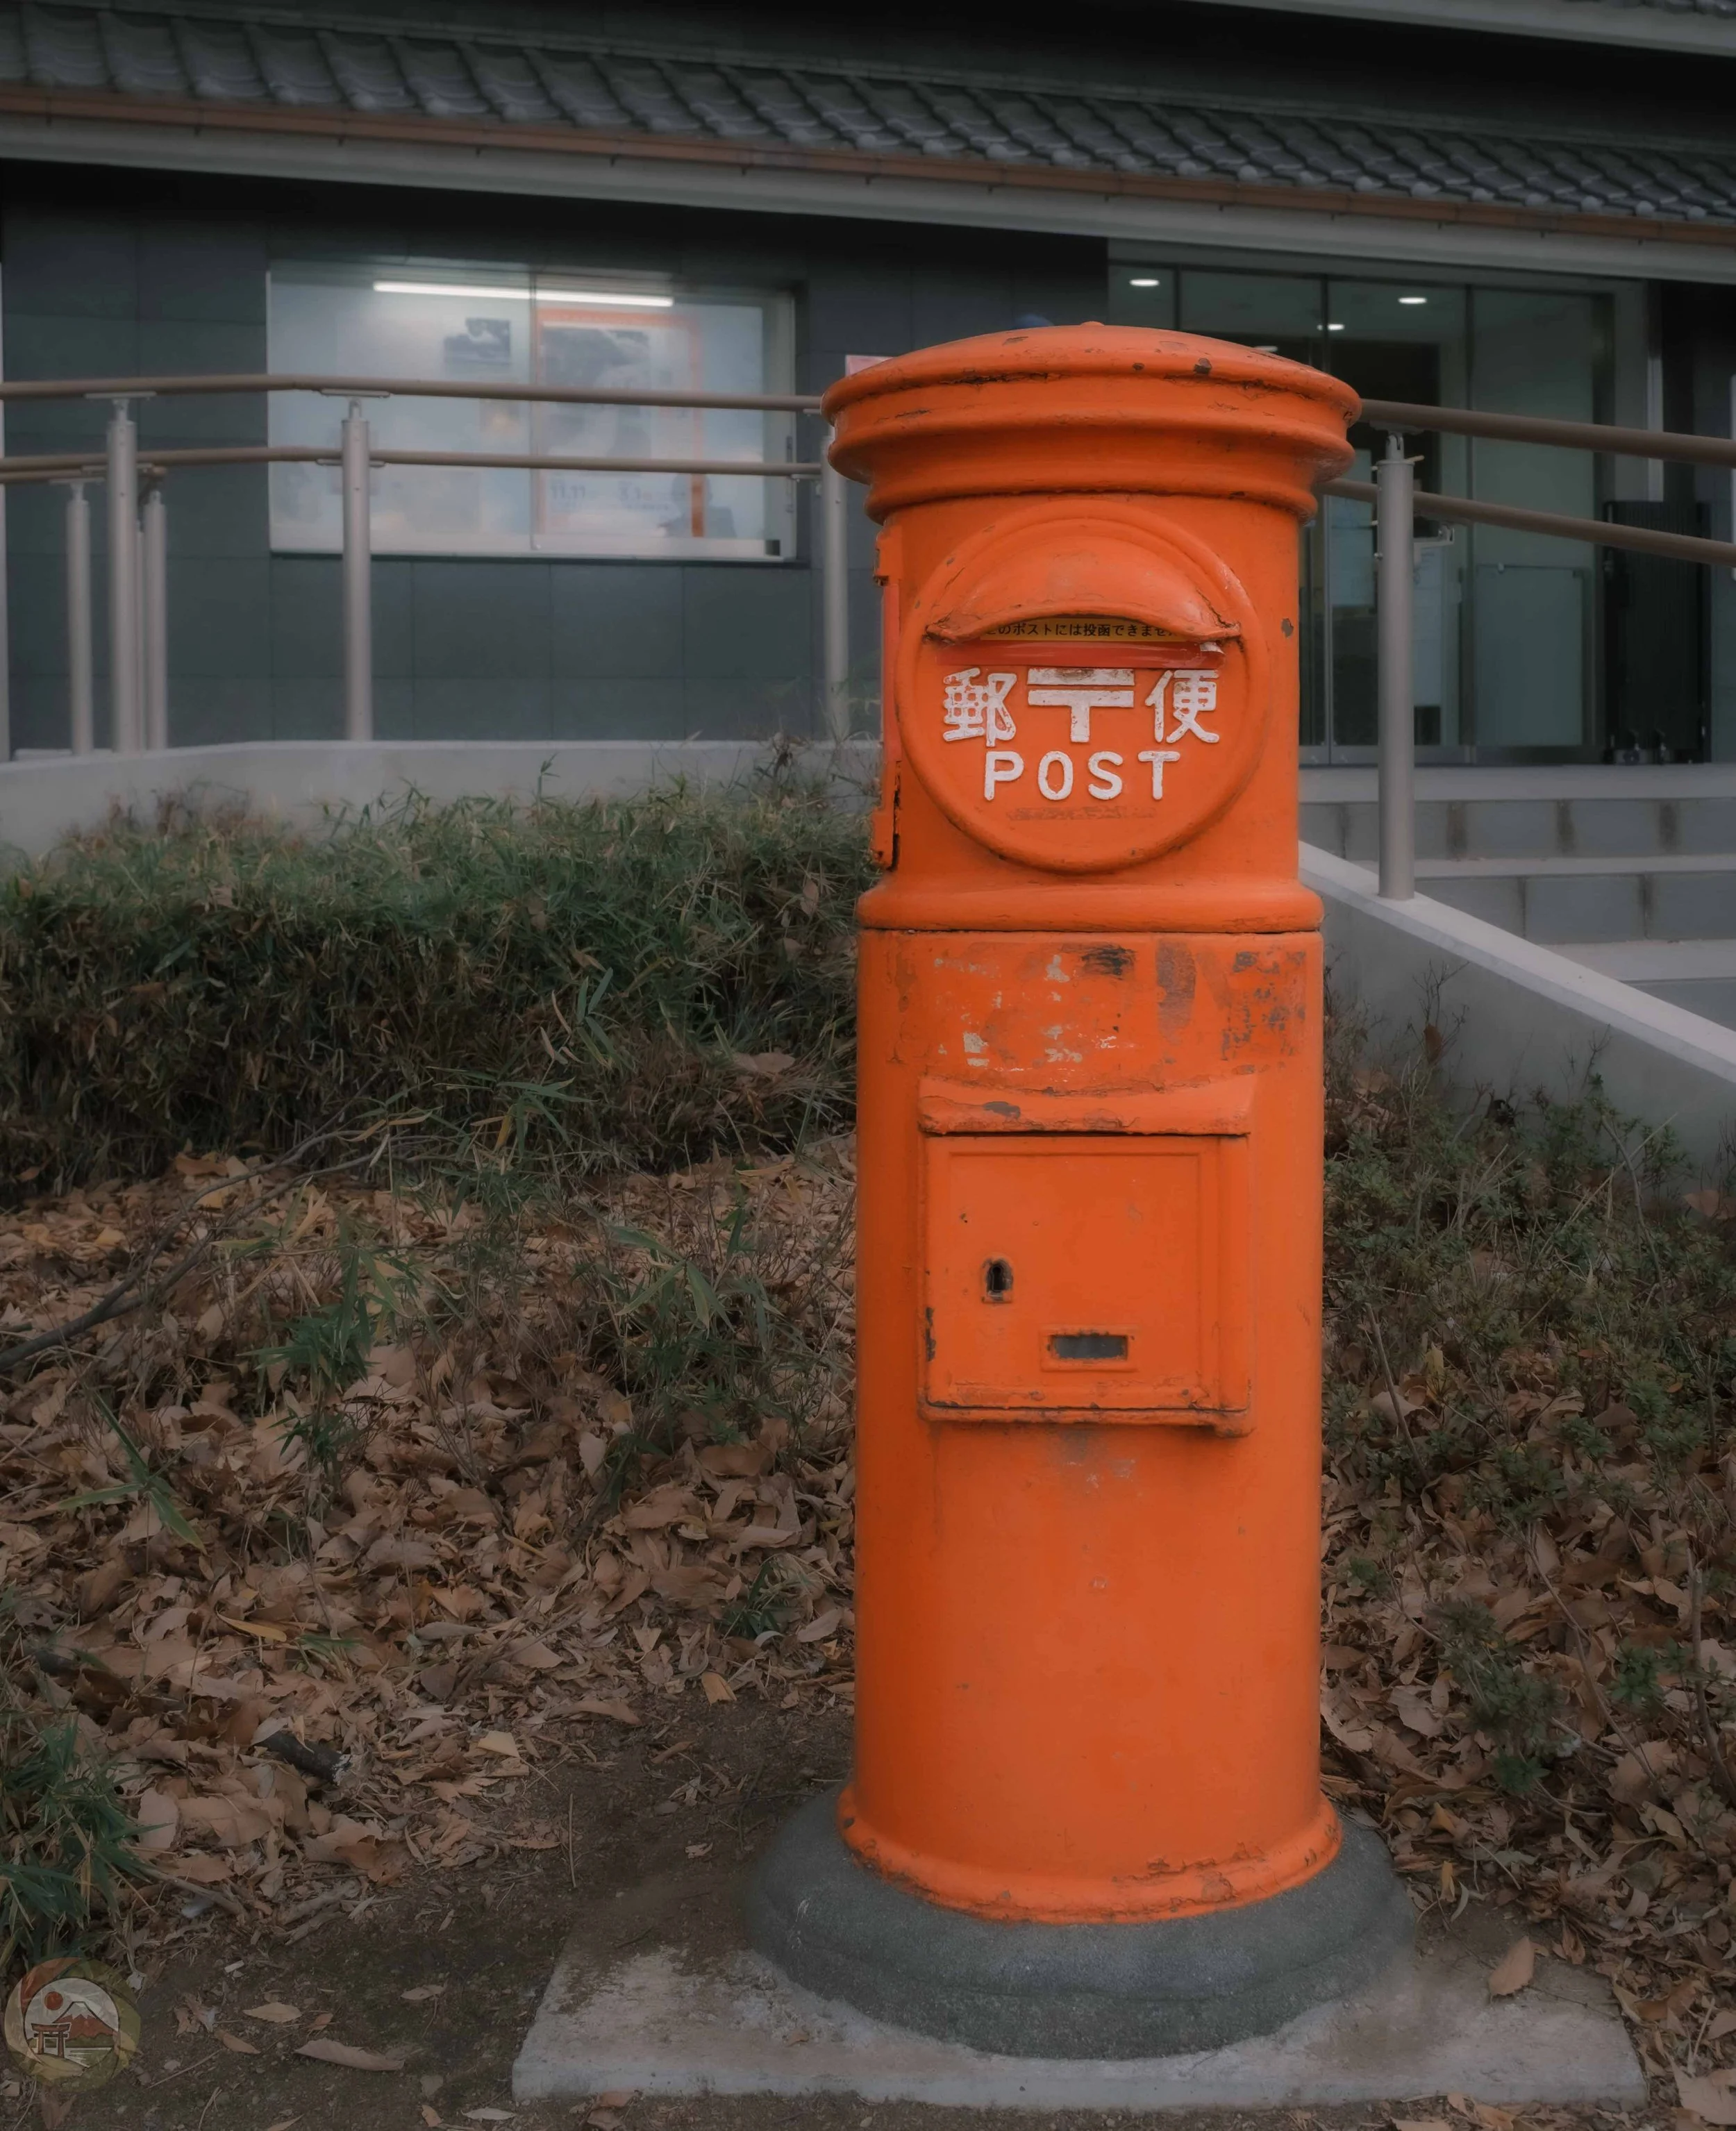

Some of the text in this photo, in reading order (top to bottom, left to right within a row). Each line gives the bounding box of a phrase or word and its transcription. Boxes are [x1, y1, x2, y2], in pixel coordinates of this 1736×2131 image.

[986, 624, 1176, 637] のポストには投函できませ
[984, 751, 1180, 801] POST
